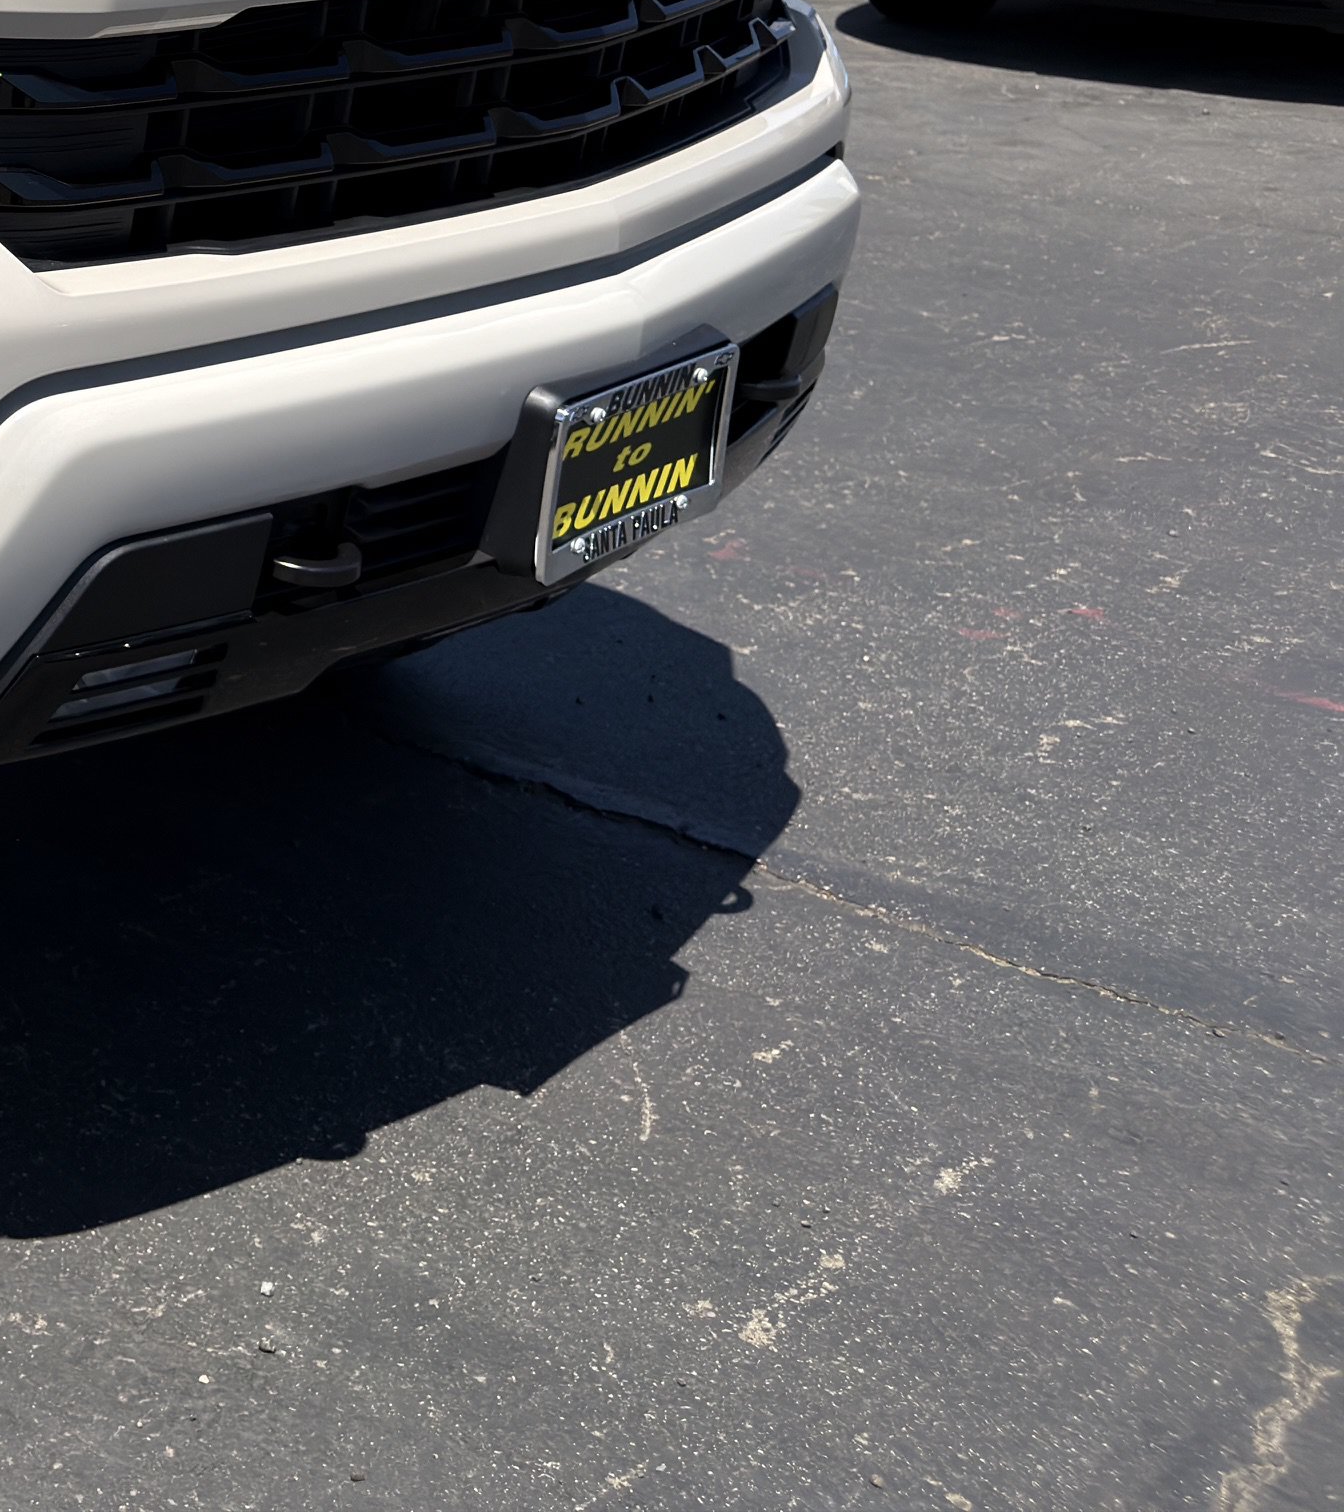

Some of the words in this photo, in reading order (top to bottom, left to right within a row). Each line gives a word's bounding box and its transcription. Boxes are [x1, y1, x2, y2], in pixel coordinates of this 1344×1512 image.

[562, 380, 715, 462] RUNNIN'
[613, 442, 652, 473] to
[552, 453, 698, 539] BUNNIN
